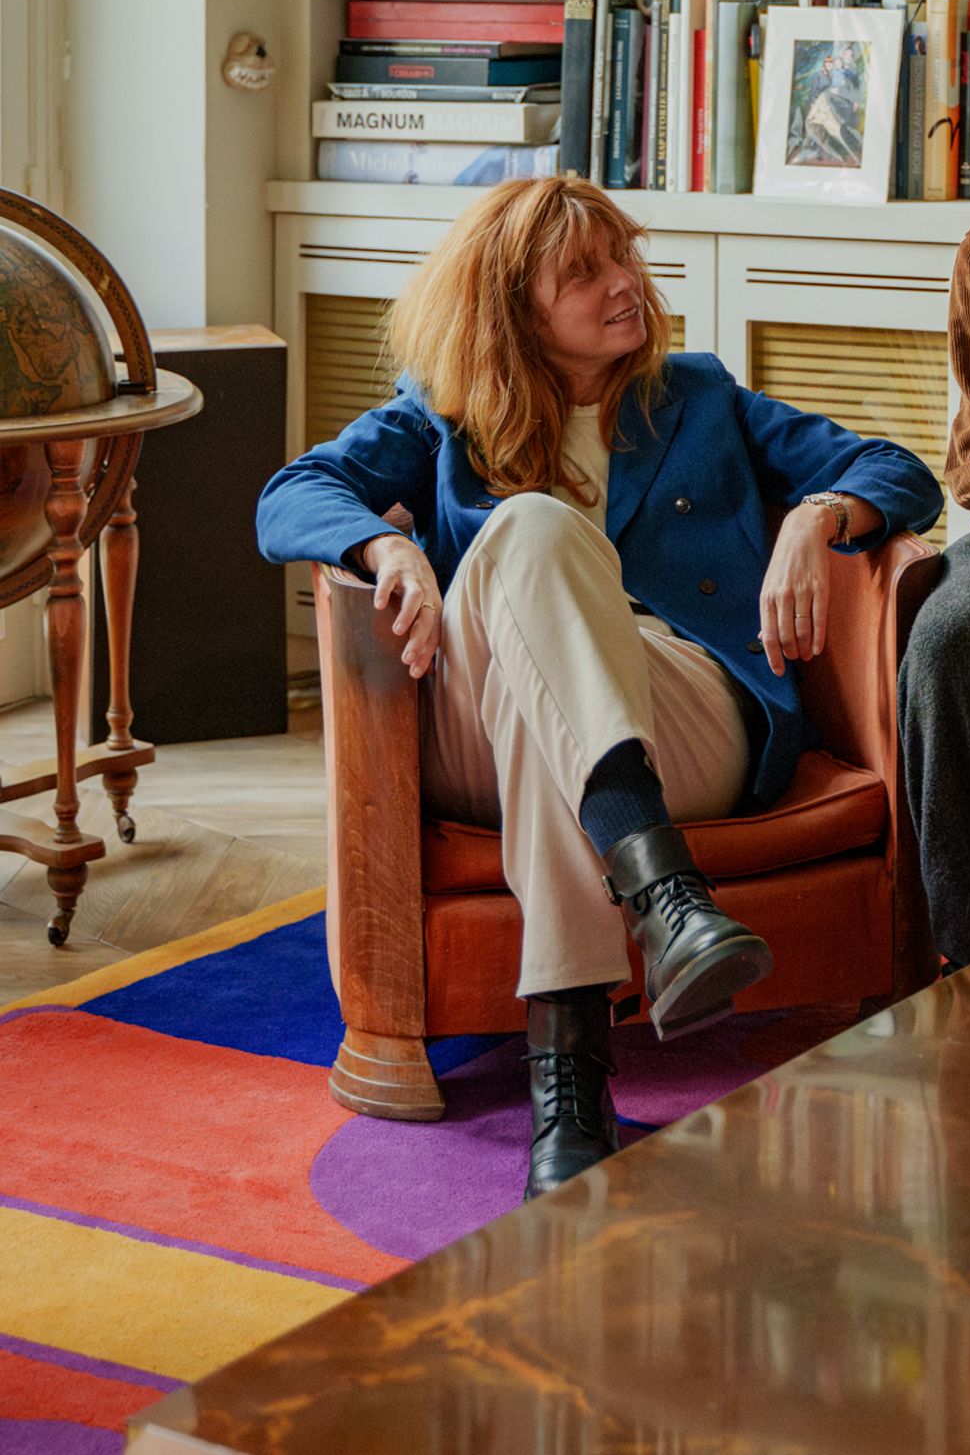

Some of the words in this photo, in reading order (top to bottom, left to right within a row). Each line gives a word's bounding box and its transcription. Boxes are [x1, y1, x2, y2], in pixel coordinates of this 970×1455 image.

[914, 60, 923, 98] LYRICS
[337, 113, 424, 130] MAGNUM
[429, 115, 517, 131] MAGNUM
[658, 91, 667, 139] STORIES
[913, 112, 923, 148] DYLAN
[913, 150, 922, 174] BOB
